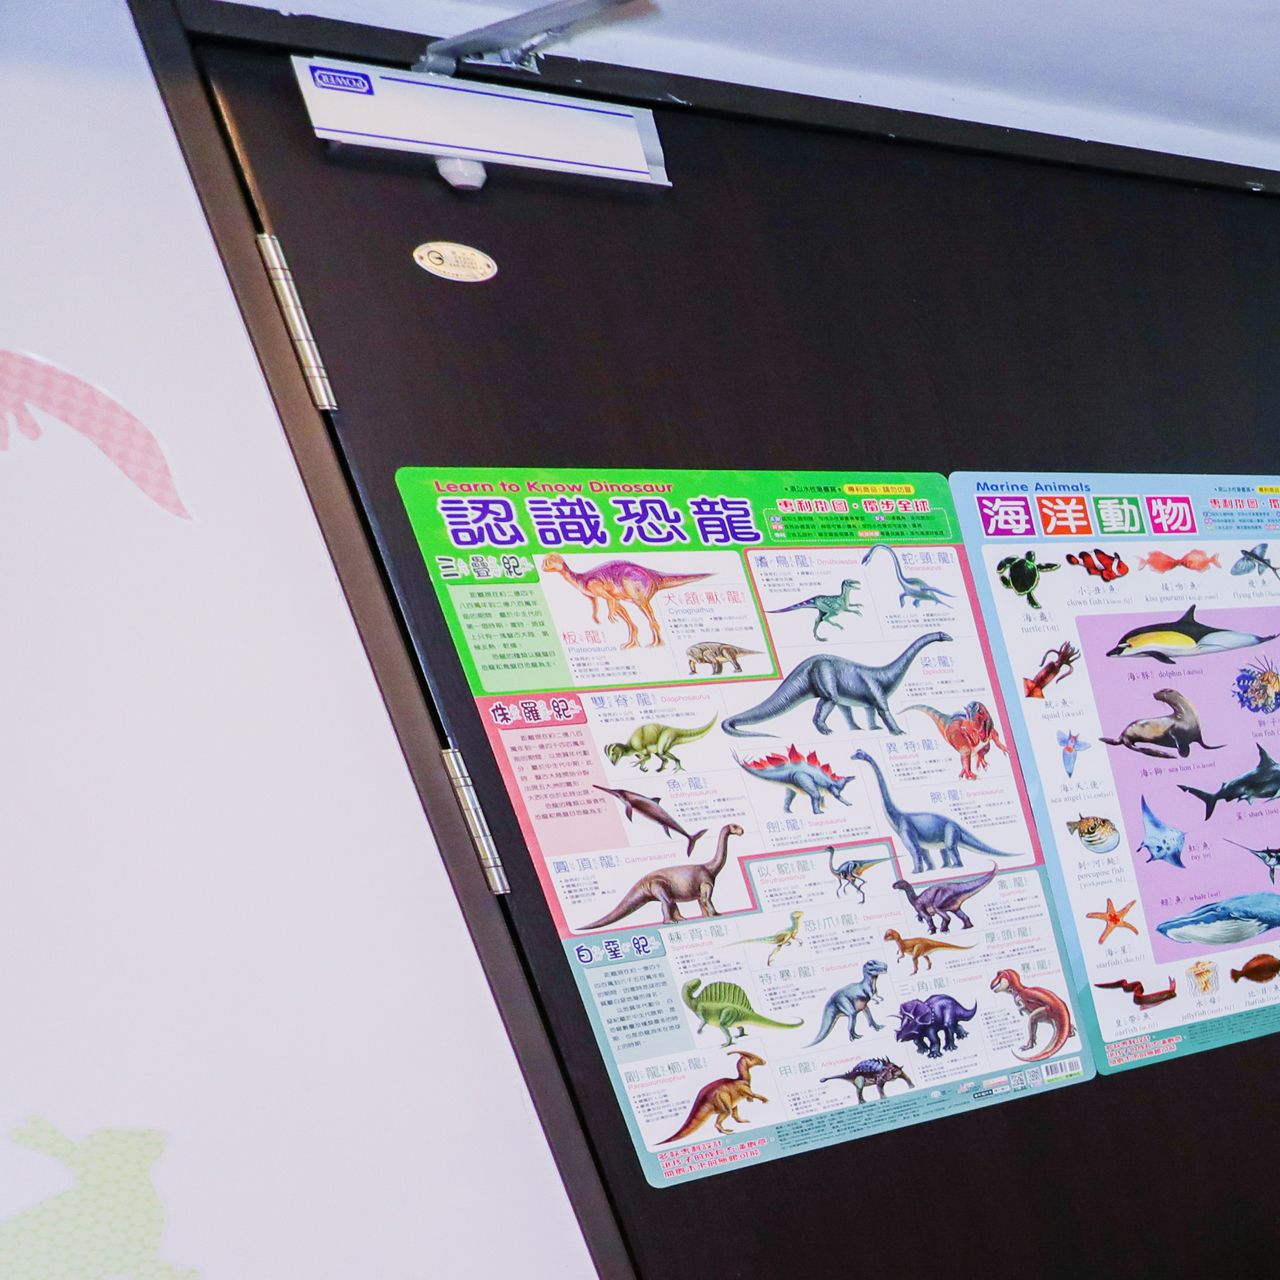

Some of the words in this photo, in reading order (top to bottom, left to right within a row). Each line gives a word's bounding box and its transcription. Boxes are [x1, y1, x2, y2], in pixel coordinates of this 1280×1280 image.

[320, 73, 366, 89] POWER
[434, 480, 494, 493] Learn
[500, 481, 520, 493] to
[527, 480, 583, 493] Know
[590, 480, 674, 493] Dinosaur
[975, 480, 1029, 493] Marine
[1034, 480, 1091, 493] Animals
[439, 497, 762, 546] 認識恐龍
[978, 495, 1195, 536] 海洋動物
[437, 554, 534, 579] 三疊紀
[563, 631, 607, 645] 板龍
[568, 646, 617, 654] Plateosaurus
[491, 699, 582, 723] 侏羅紀
[575, 936, 660, 963] 白堊紀
